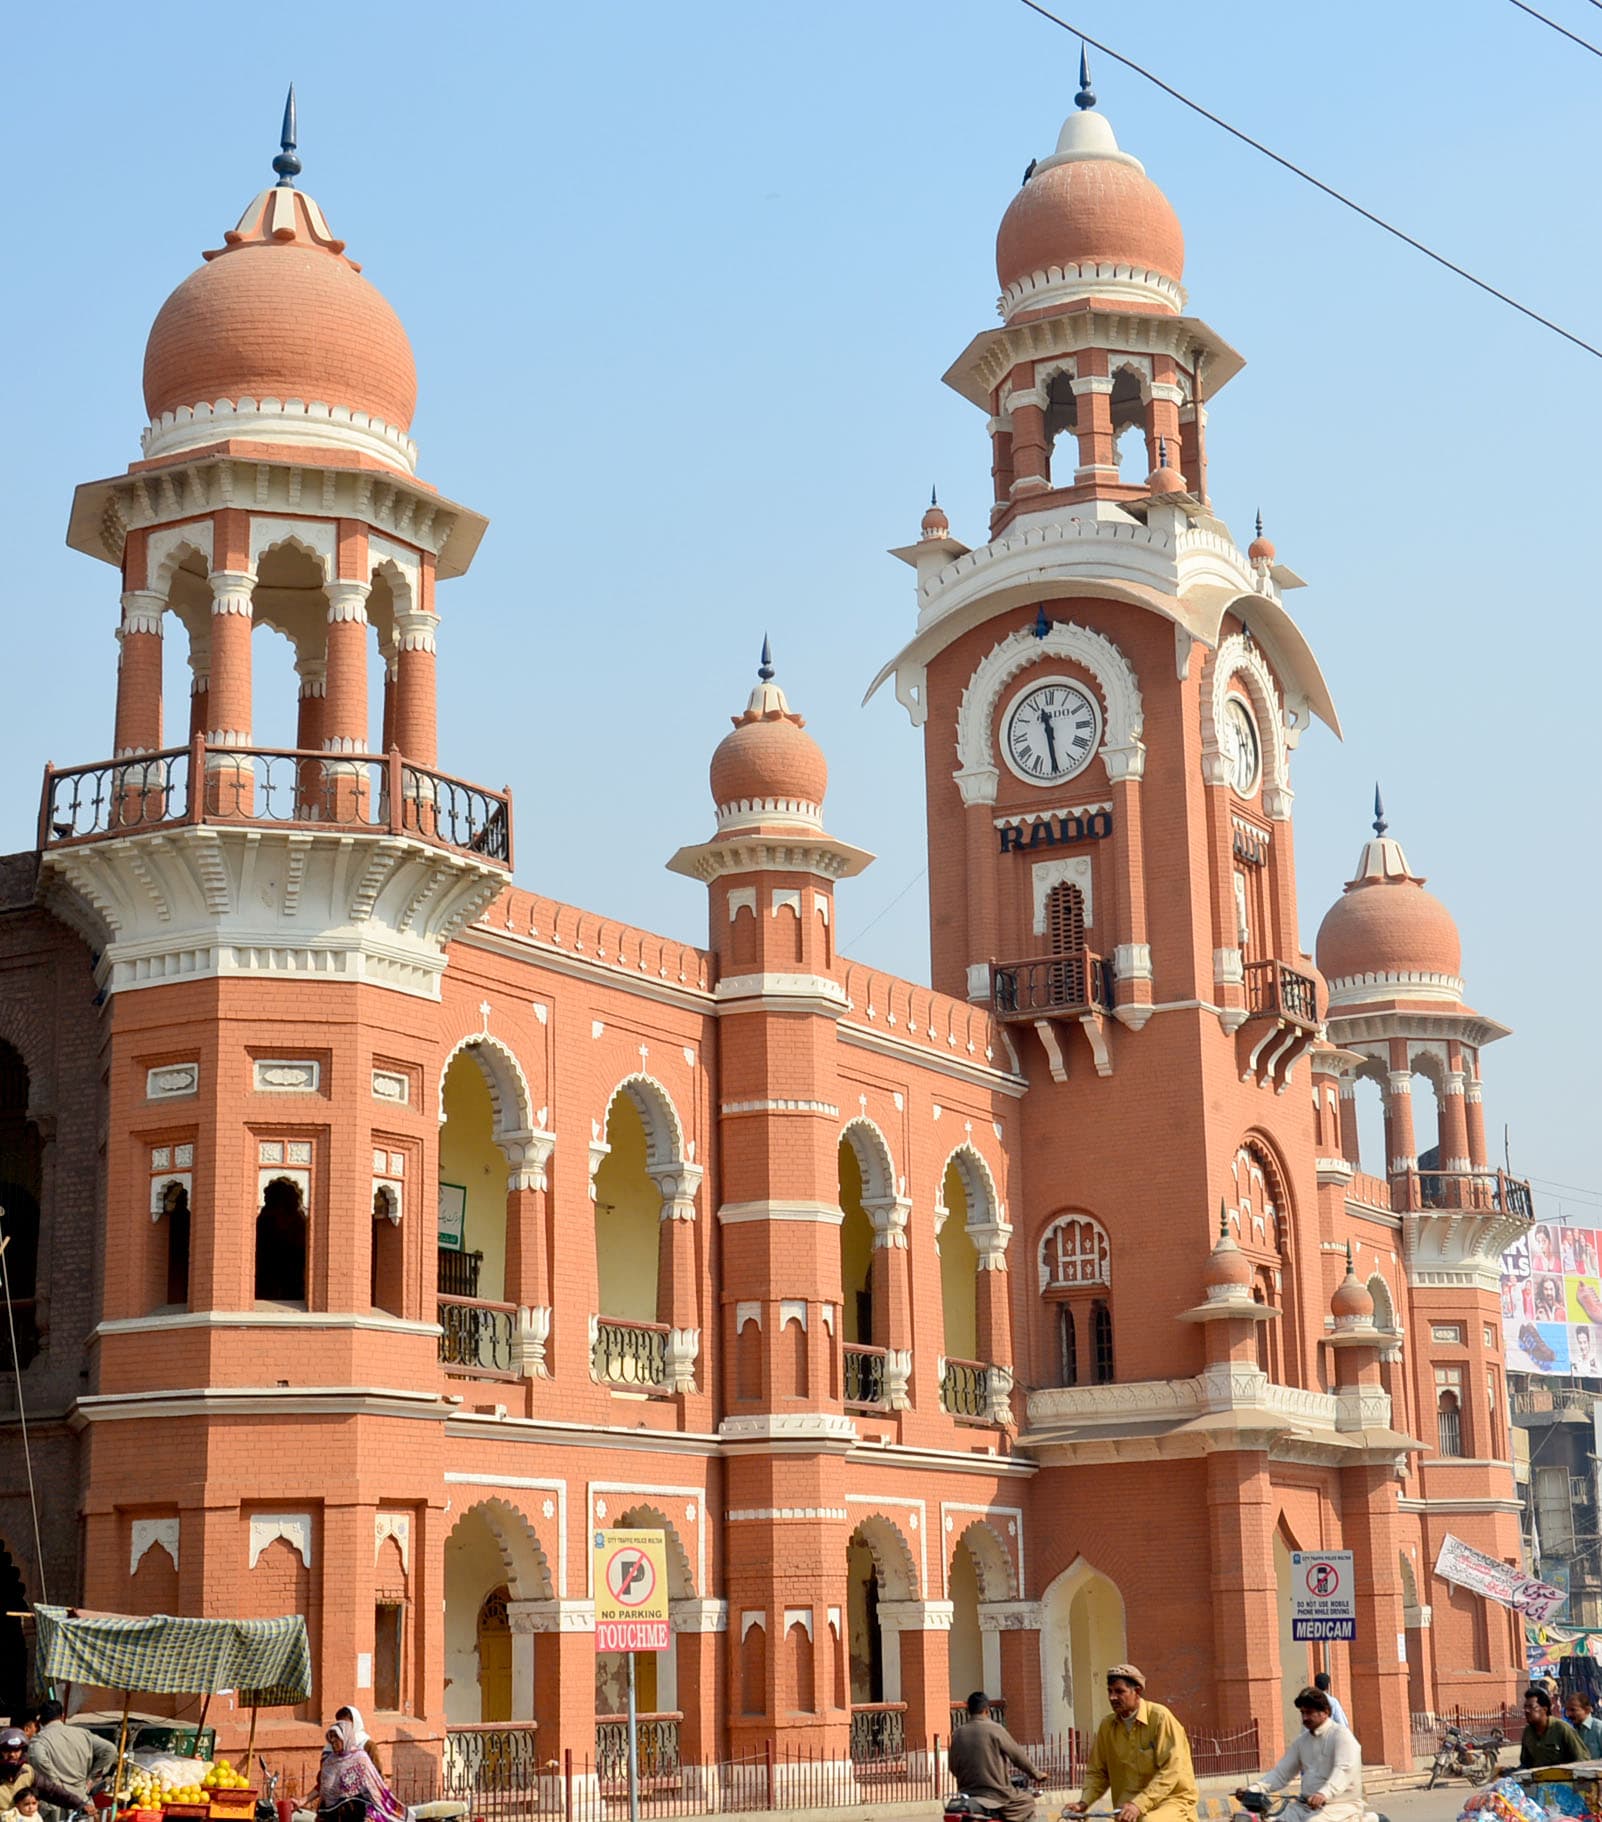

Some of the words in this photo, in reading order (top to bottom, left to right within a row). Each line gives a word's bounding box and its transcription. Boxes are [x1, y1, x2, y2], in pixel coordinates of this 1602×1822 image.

[1000, 812, 1113, 854] RADO
[601, 1611, 615, 1619] NO
[619, 1610, 662, 1619] PARKING
[598, 1624, 668, 1649] TOUCHME
[1296, 1621, 1352, 1638] MEDICAM
